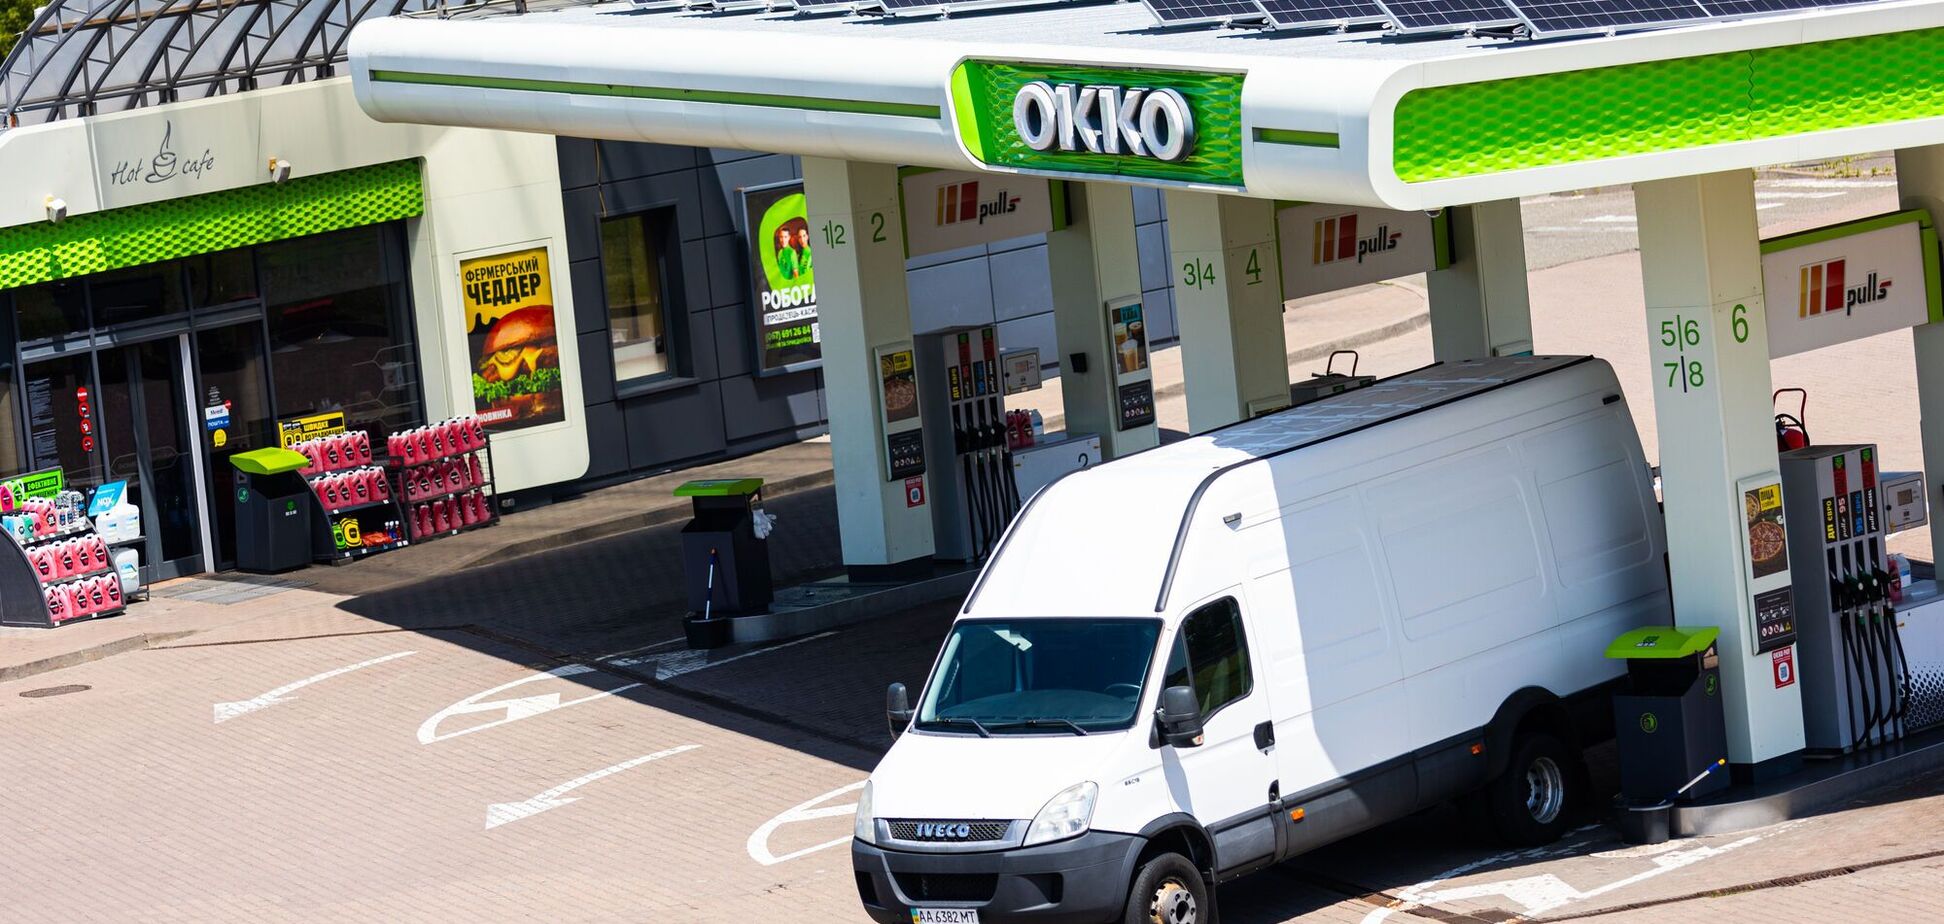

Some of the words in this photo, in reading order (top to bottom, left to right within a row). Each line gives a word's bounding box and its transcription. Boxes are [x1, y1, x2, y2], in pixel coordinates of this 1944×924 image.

[1013, 81, 1194, 162] OKKO
[112, 157, 143, 185] Hot
[182, 149, 214, 180] cafe
[979, 191, 1021, 225] pulls
[871, 212, 886, 243] 2
[1358, 225, 1402, 264] pulls
[465, 256, 539, 283] ФЕРМЕРСЬКИЙ
[1246, 248, 1262, 281] 4
[466, 272, 541, 307] ЧЕДДЕР
[1846, 272, 1892, 316] pulls
[1732, 303, 1749, 343] 6
[1838, 498, 1846, 513] 95
[1827, 524, 1836, 539] ДП
[916, 823, 970, 839] IVECO
[920, 911, 934, 923] AA
[935, 911, 959, 923] 6382
[960, 911, 975, 924] MT
